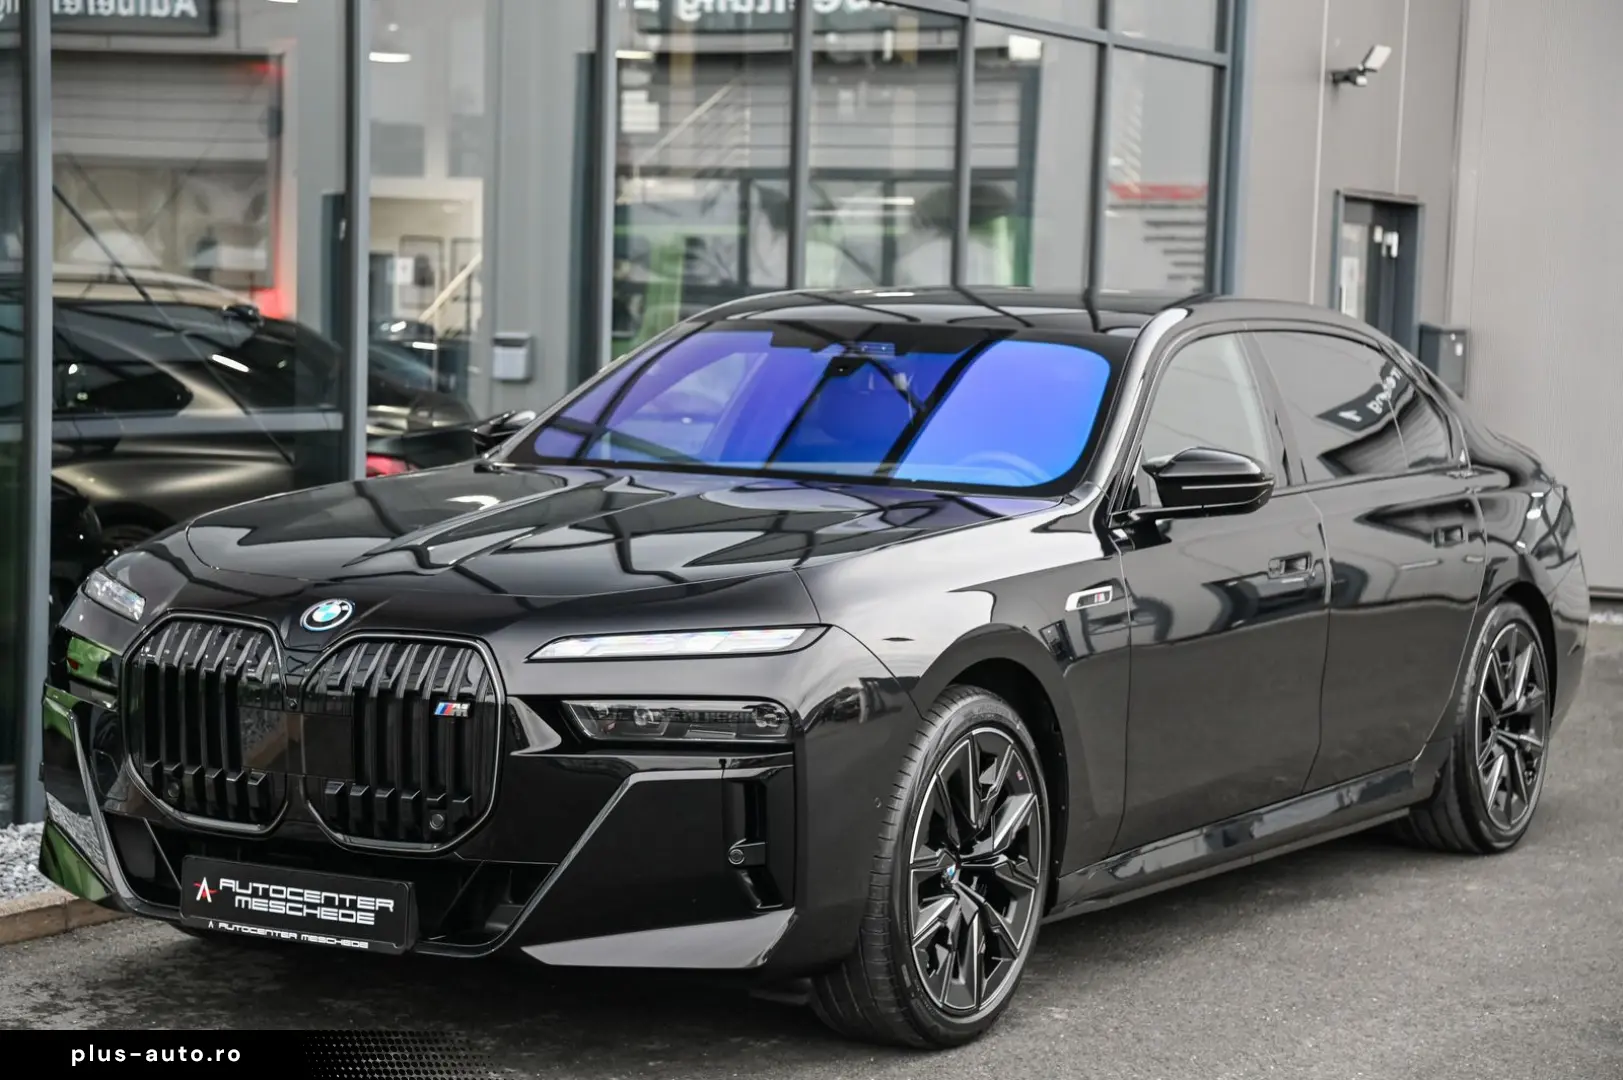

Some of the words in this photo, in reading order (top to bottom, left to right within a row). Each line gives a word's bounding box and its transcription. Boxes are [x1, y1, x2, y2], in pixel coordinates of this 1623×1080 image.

[219, 878, 395, 912] AUTOCENTER
[235, 895, 375, 926] MESCHEDE
[218, 922, 298, 940] AUTOCENTER
[300, 932, 369, 949] MESCHEDE
